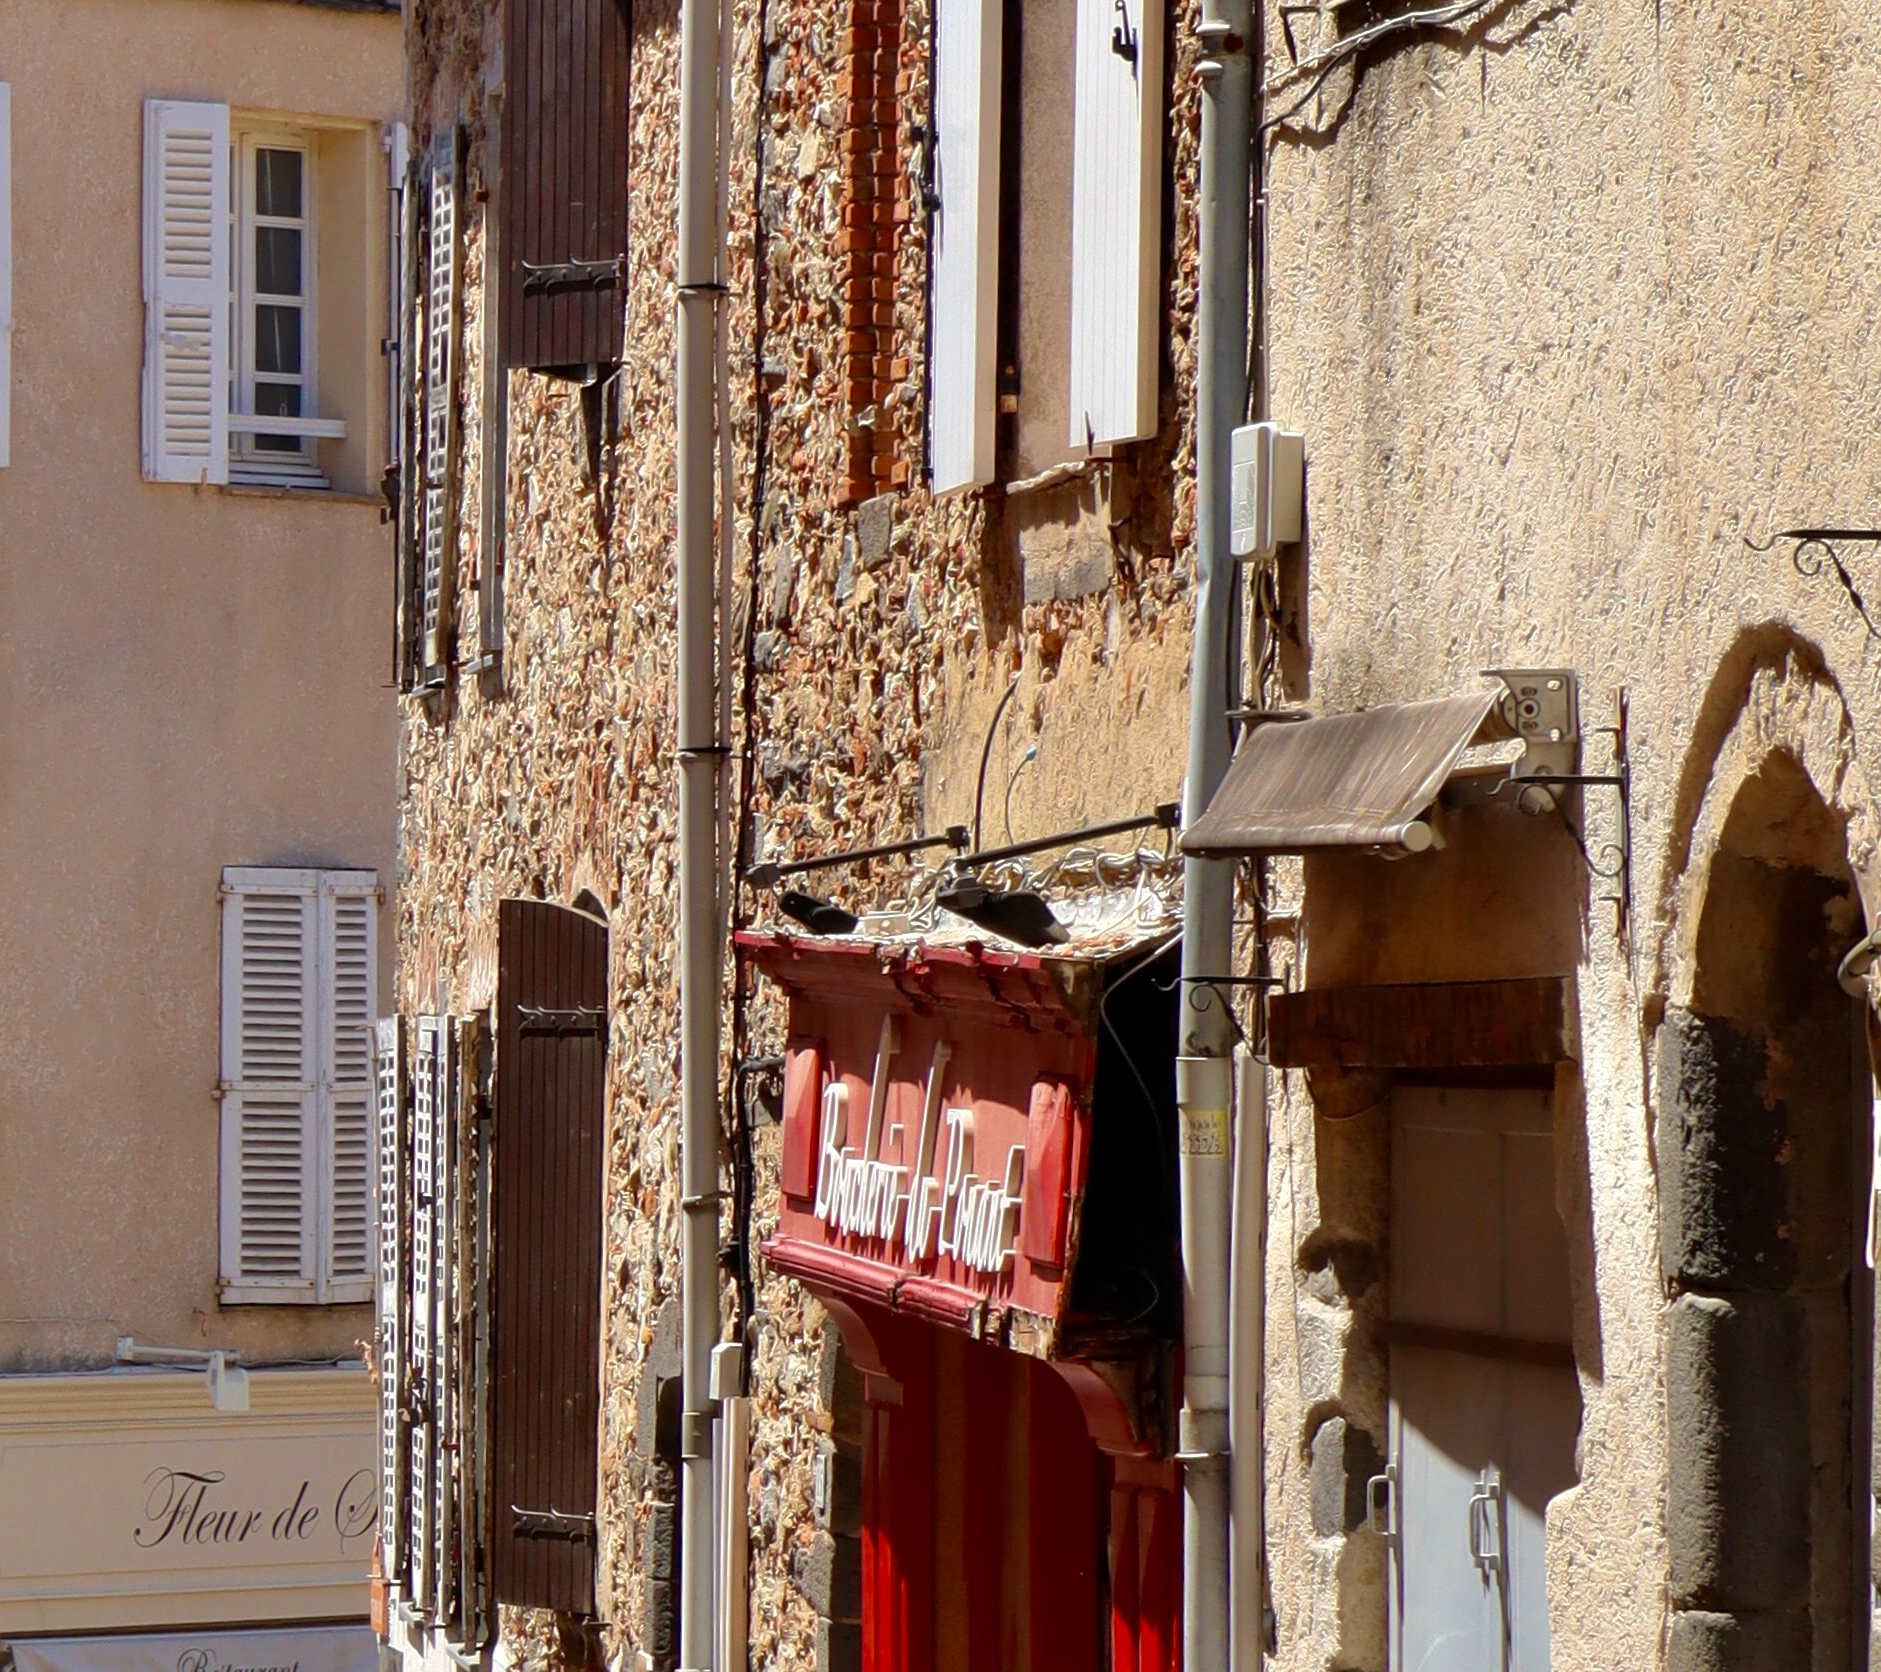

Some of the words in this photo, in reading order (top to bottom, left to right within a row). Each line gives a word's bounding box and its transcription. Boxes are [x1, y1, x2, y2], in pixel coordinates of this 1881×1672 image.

[813, 1013, 909, 1240] Boucherie
[904, 1039, 951, 1264] du
[937, 1107, 1026, 1273] Ponant
[134, 1466, 262, 1548] Fleur
[271, 1480, 320, 1541] de
